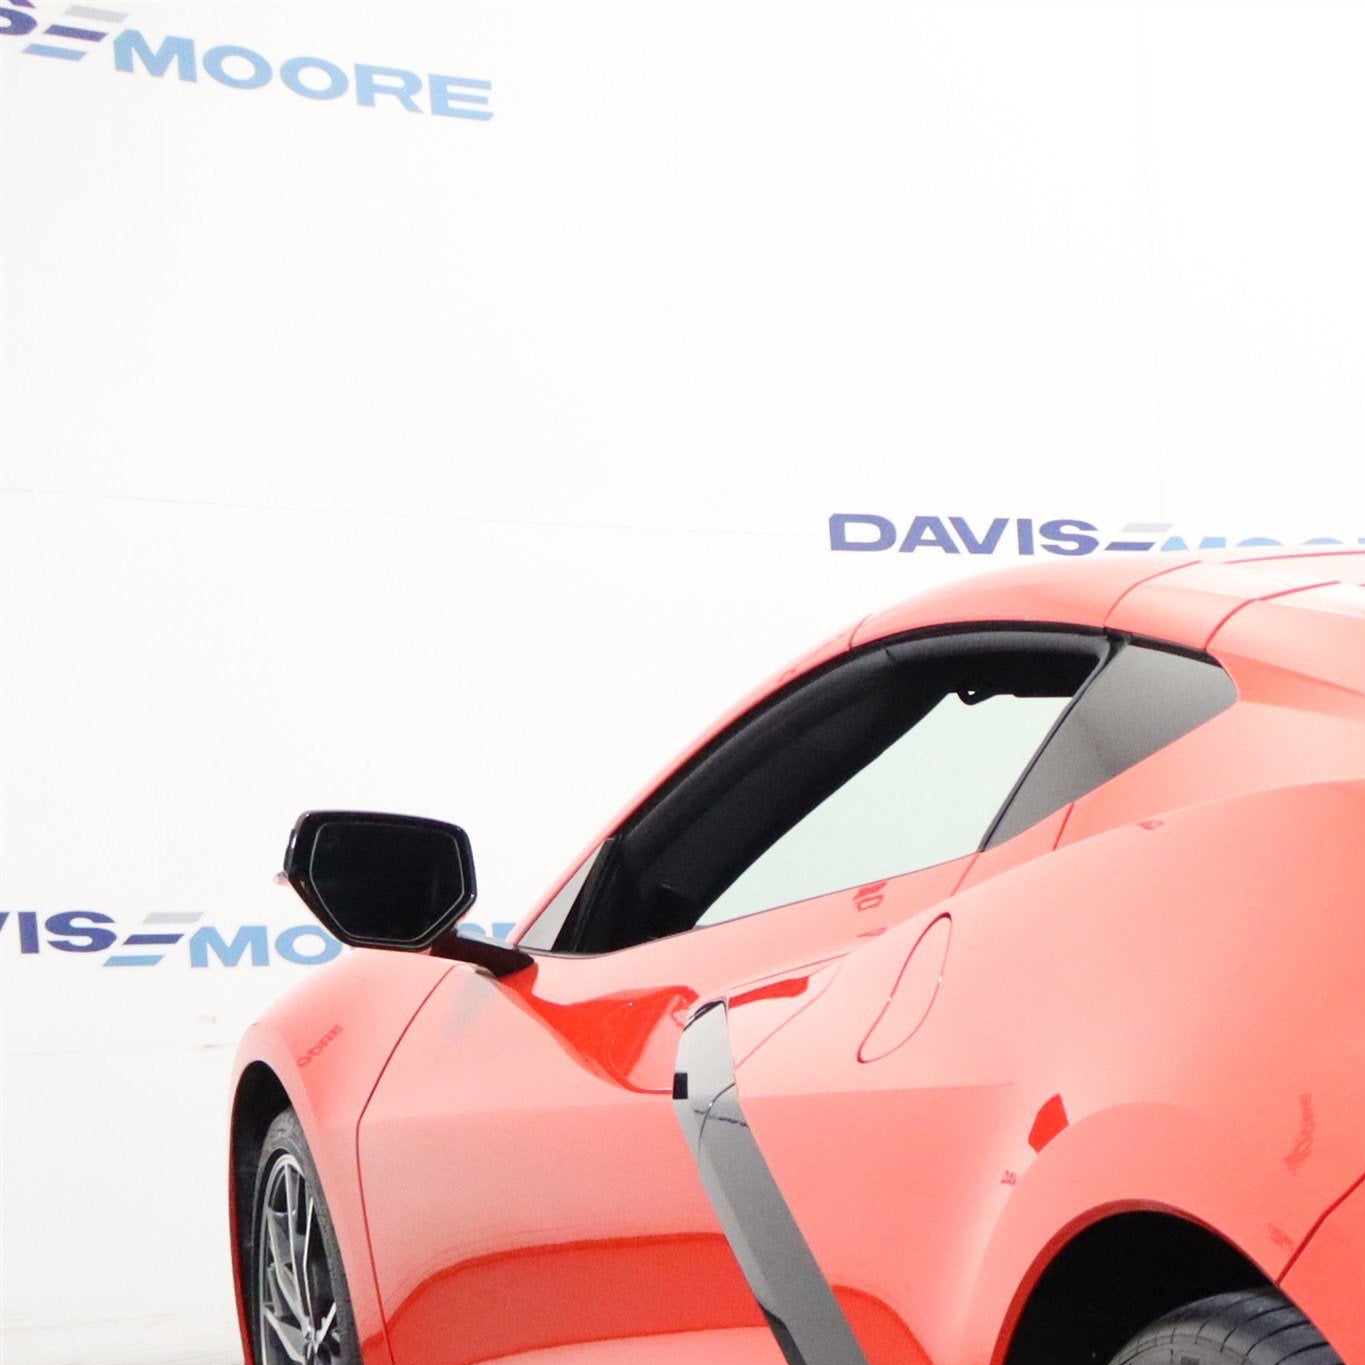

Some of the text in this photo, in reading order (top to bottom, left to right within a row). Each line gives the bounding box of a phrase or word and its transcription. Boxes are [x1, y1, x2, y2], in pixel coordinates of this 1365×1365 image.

[112, 28, 495, 122] MOORE
[828, 513, 1100, 556] DAVIS
[0, 911, 117, 954] IS
